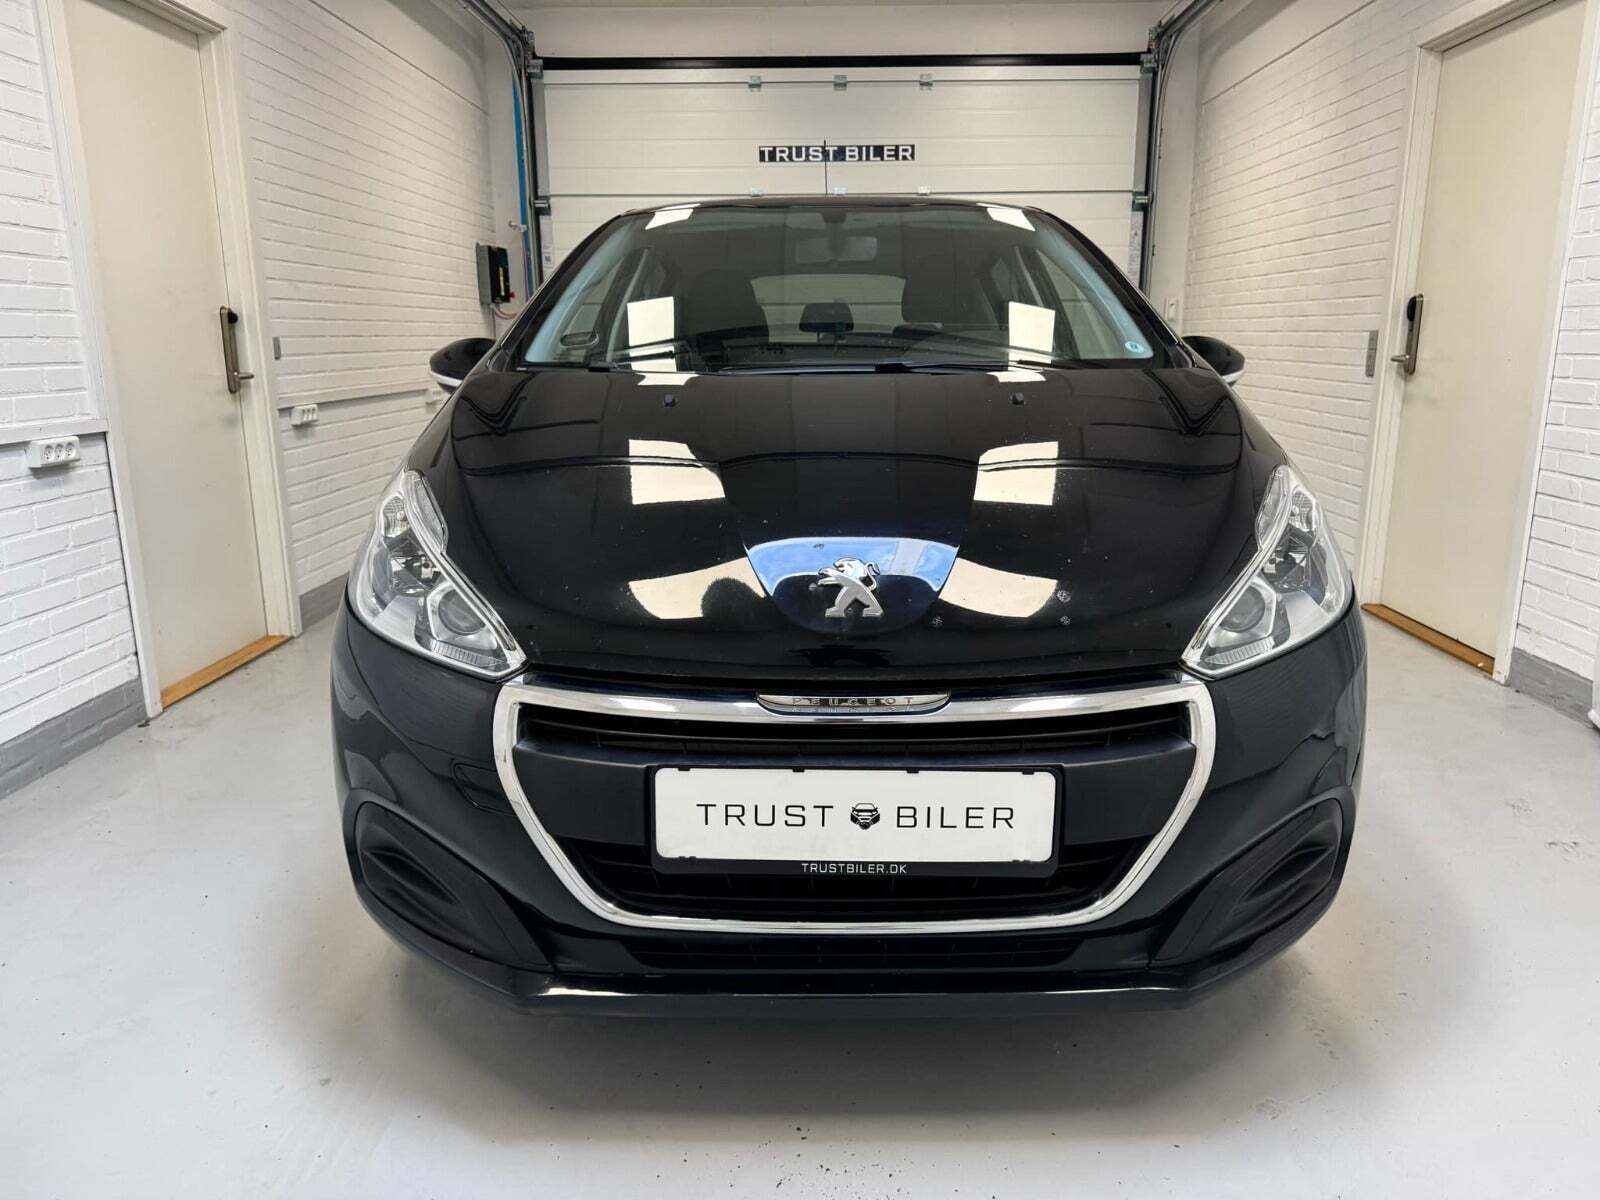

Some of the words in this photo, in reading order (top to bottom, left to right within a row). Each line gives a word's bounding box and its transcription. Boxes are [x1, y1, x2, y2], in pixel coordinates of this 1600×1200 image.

[760, 147, 838, 161] TRUST
[845, 145, 913, 161] BILER
[792, 697, 913, 706] PEUGEOT
[696, 803, 834, 828] TRUST
[896, 806, 1014, 829] BILER
[801, 863, 908, 875] TRUSTBILER.DK
